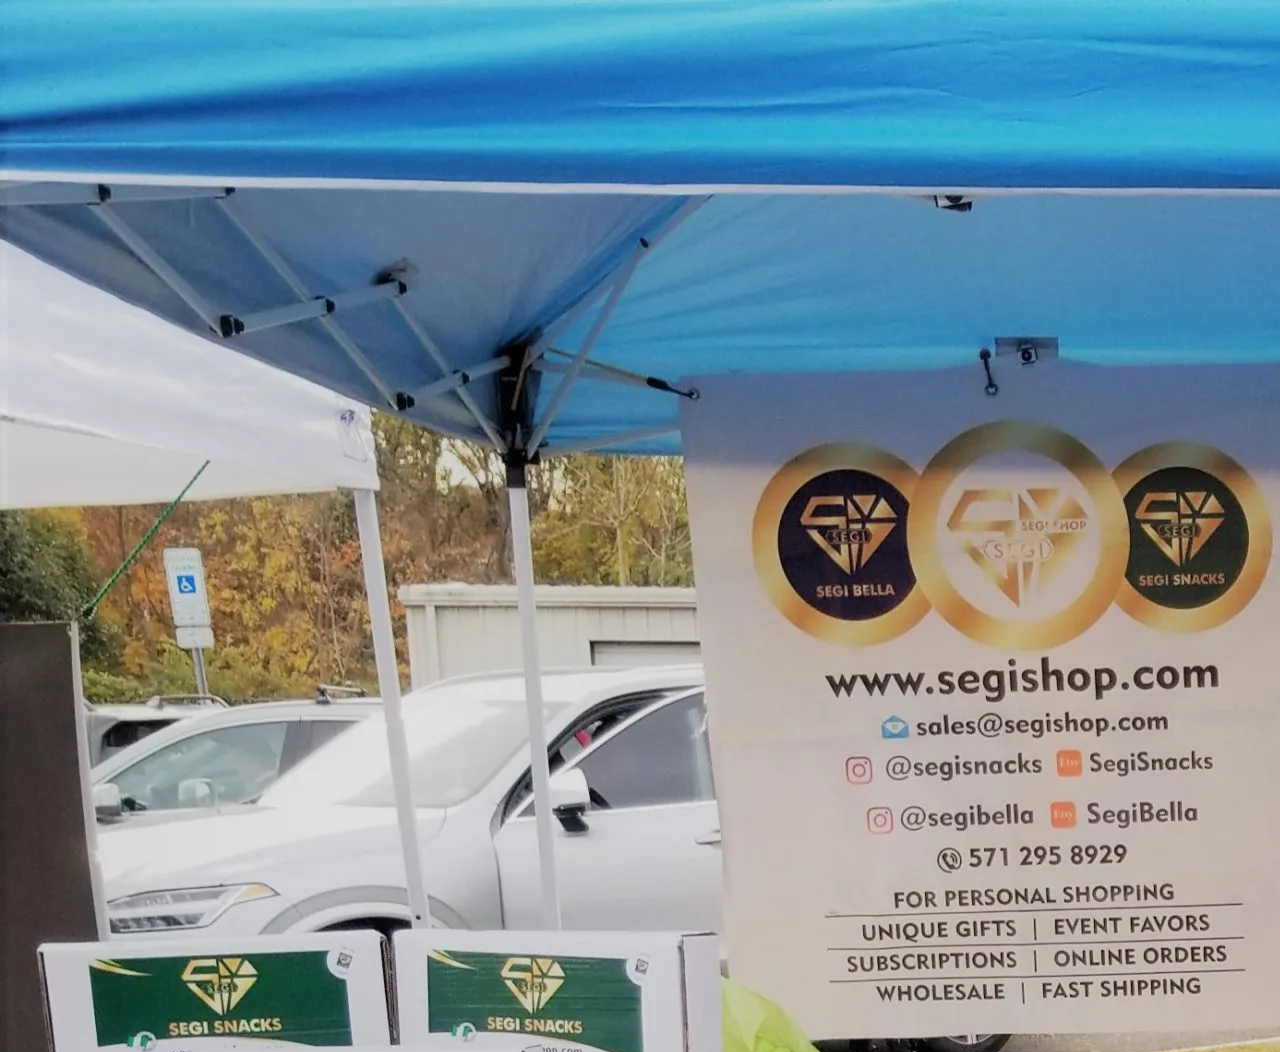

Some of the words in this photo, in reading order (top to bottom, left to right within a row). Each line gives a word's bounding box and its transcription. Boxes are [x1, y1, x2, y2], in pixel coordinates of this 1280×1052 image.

[816, 586, 849, 598] SEGI
[853, 583, 896, 598] BELLA
[1139, 574, 1169, 586] SEGI
[1172, 572, 1226, 586] SNACKS
[825, 658, 1220, 702] www.segishop.com
[916, 713, 1169, 737] sales@segishop.com
[886, 755, 1042, 782] @segisnacks
[1089, 752, 1214, 777] SegiSnacks
[900, 805, 1035, 832] @segibella
[1087, 804, 1198, 827] SegiBella
[969, 847, 1010, 867] 571
[1019, 846, 1063, 867] 295
[1070, 845, 1128, 865] 8929
[893, 890, 938, 909] FOR
[944, 886, 1057, 907] PERSONAL
[1063, 883, 1174, 903] SHOPPING
[862, 923, 951, 943] UNIQUE
[956, 919, 1017, 939] GIFTS
[1054, 917, 1124, 936] EVENT
[1130, 915, 1211, 933] FAVORS
[847, 952, 1018, 973] SUBSCRIPTIONS
[1054, 948, 1138, 967] ONLINE
[1144, 945, 1227, 964] ORDERS
[876, 983, 1005, 1003] WHOLESALE
[1042, 981, 1096, 999] FAST
[1101, 977, 1201, 997] SHIPPING
[168, 1021, 209, 1035] SEGI
[214, 1018, 282, 1034] SNACKS
[487, 1016, 521, 1031] SEGI
[525, 1018, 583, 1034] SNACKS
